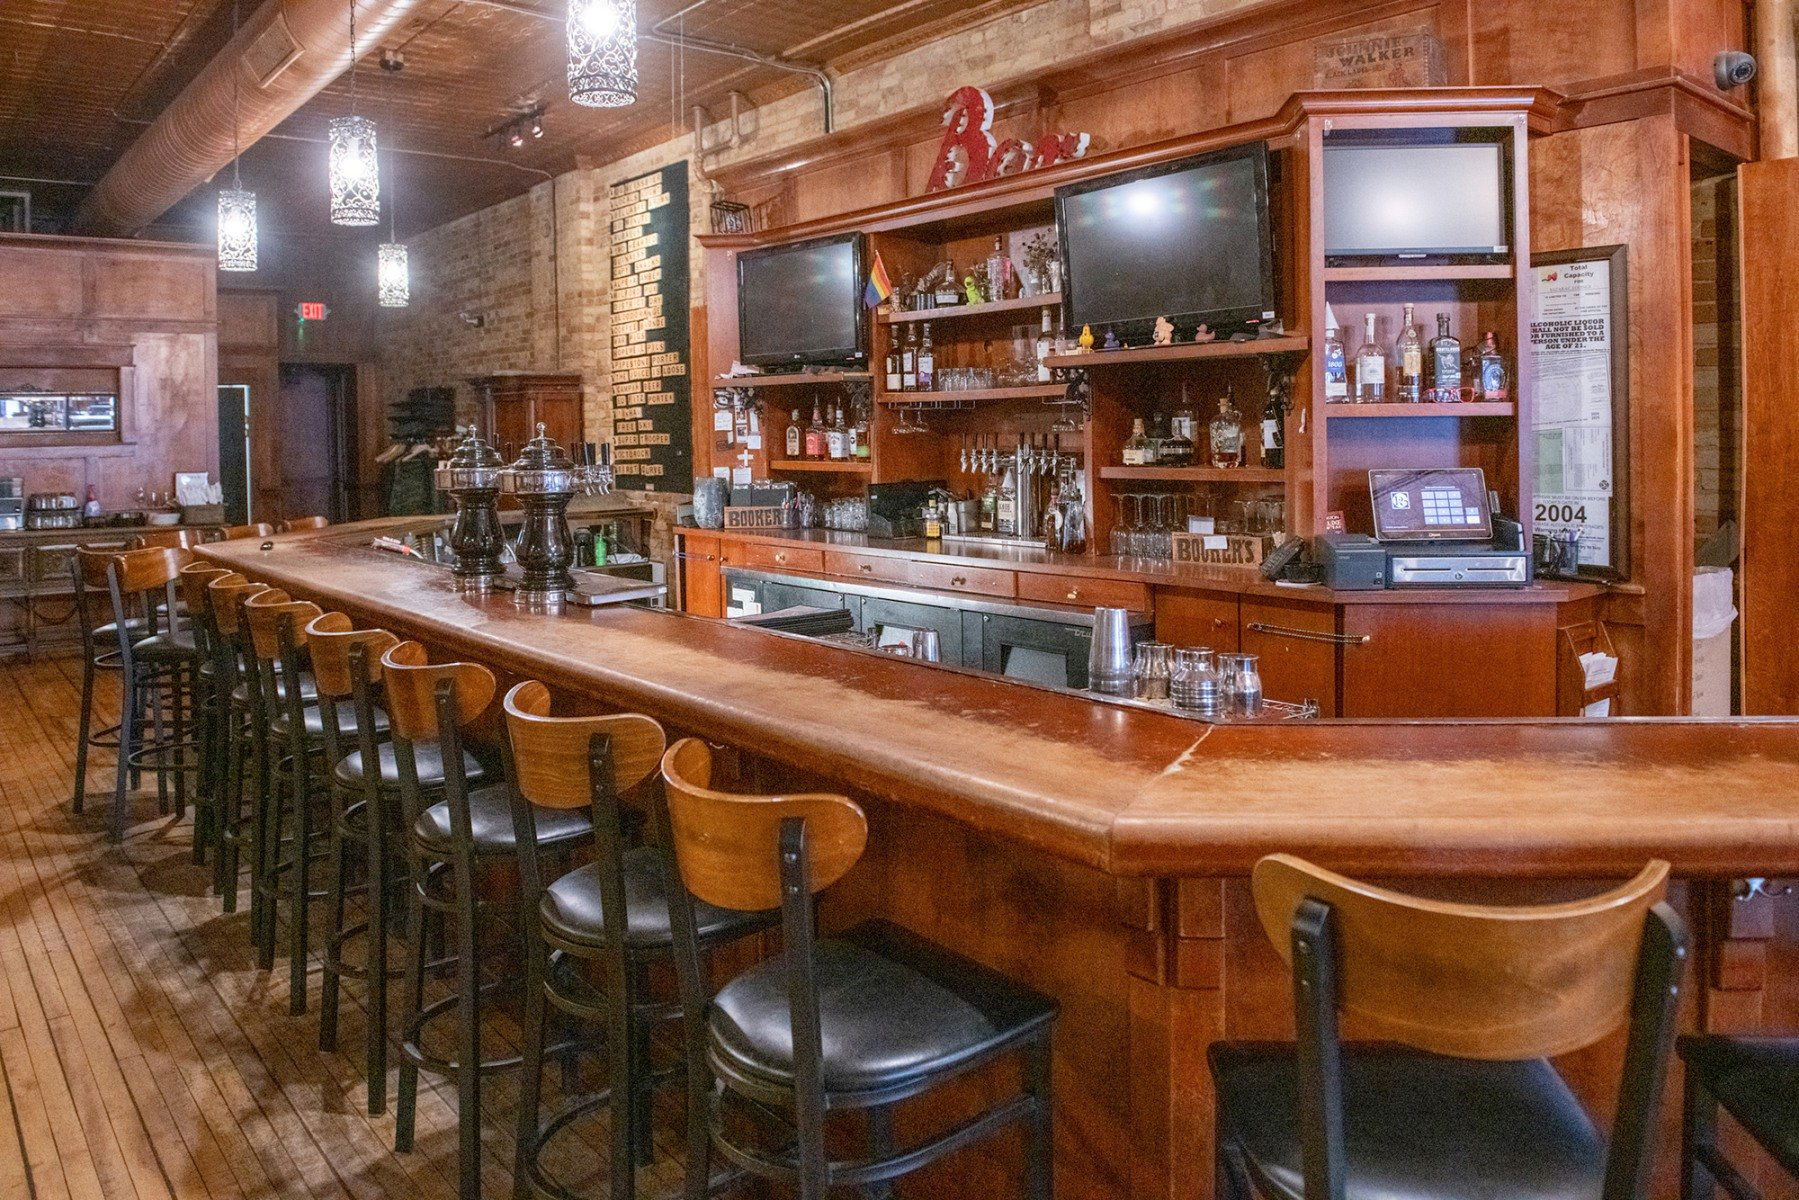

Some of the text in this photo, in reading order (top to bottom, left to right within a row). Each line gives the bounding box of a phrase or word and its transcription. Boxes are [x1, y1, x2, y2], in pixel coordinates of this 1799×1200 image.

[1339, 47, 1414, 67] WALKER
[302, 303, 323, 320] EXIT
[647, 341, 663, 352] PILS
[615, 353, 677, 368] PIPESTONE PORTER
[652, 368, 660, 376] IS
[663, 365, 683, 375] LOOSE
[644, 381, 659, 390] BEER
[640, 434, 668, 442] TROOPER
[1535, 504, 1587, 523] 2004
